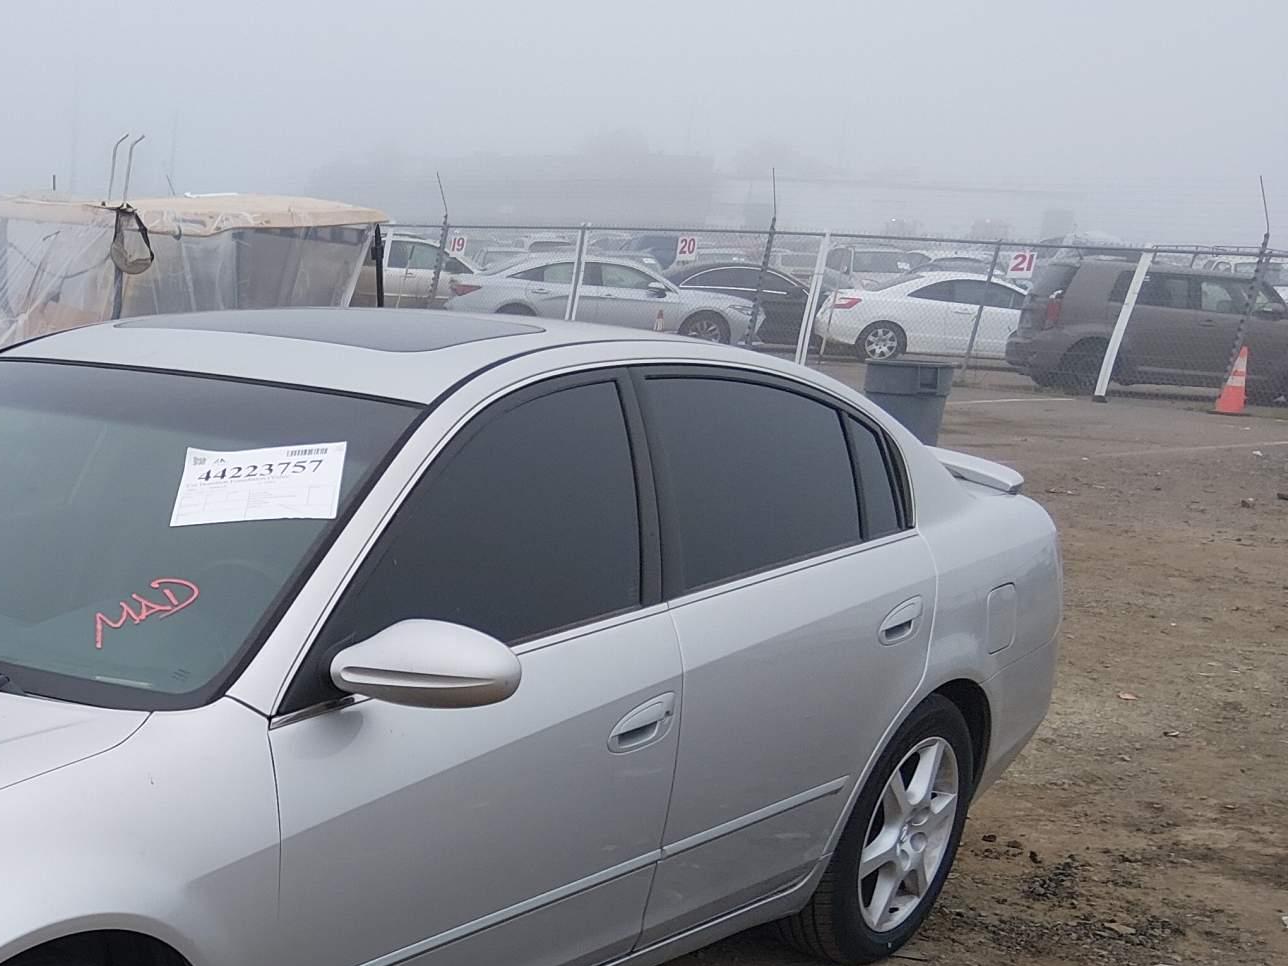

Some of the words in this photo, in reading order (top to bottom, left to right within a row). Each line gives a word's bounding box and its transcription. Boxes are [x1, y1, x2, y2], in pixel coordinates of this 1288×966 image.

[451, 237, 465, 252] 19
[679, 238, 696, 255] 20
[1010, 253, 1034, 271] 21
[198, 459, 323, 481] 44223757
[95, 577, 200, 649] MAD
